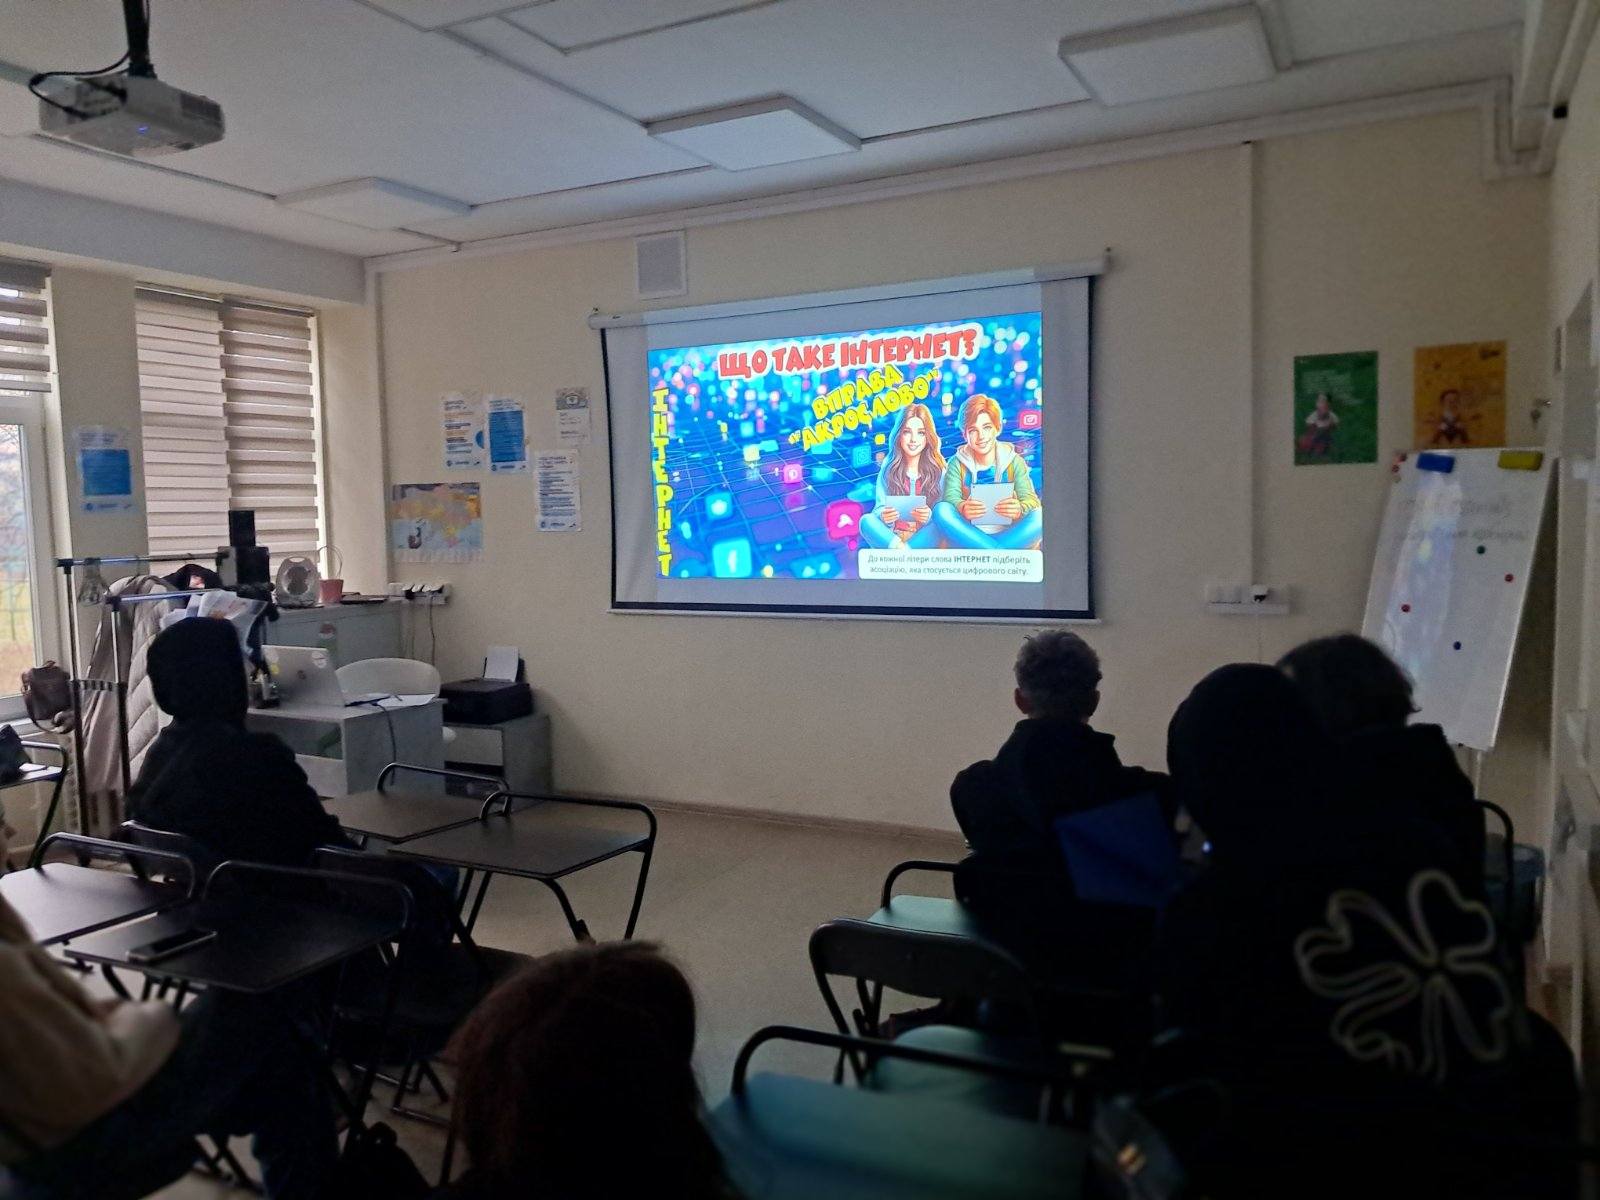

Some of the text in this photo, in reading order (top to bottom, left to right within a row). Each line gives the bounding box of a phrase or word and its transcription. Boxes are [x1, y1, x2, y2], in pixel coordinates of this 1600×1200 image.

[719, 328, 977, 378] ЩО ТАКЕ ІНТЕРНЕТ?
[812, 363, 903, 419] ВПРАВА
[652, 387, 674, 577] ІНТЕРНЕТ
[868, 554, 878, 563] До
[906, 554, 930, 564] літери
[931, 555, 952, 563] слова
[954, 555, 991, 563] ІНТЕРНЕТ
[993, 555, 1031, 565] підберіть
[923, 567, 961, 575] стосується
[963, 566, 1006, 576] цифрового
[1007, 567, 1029, 576] світу.
